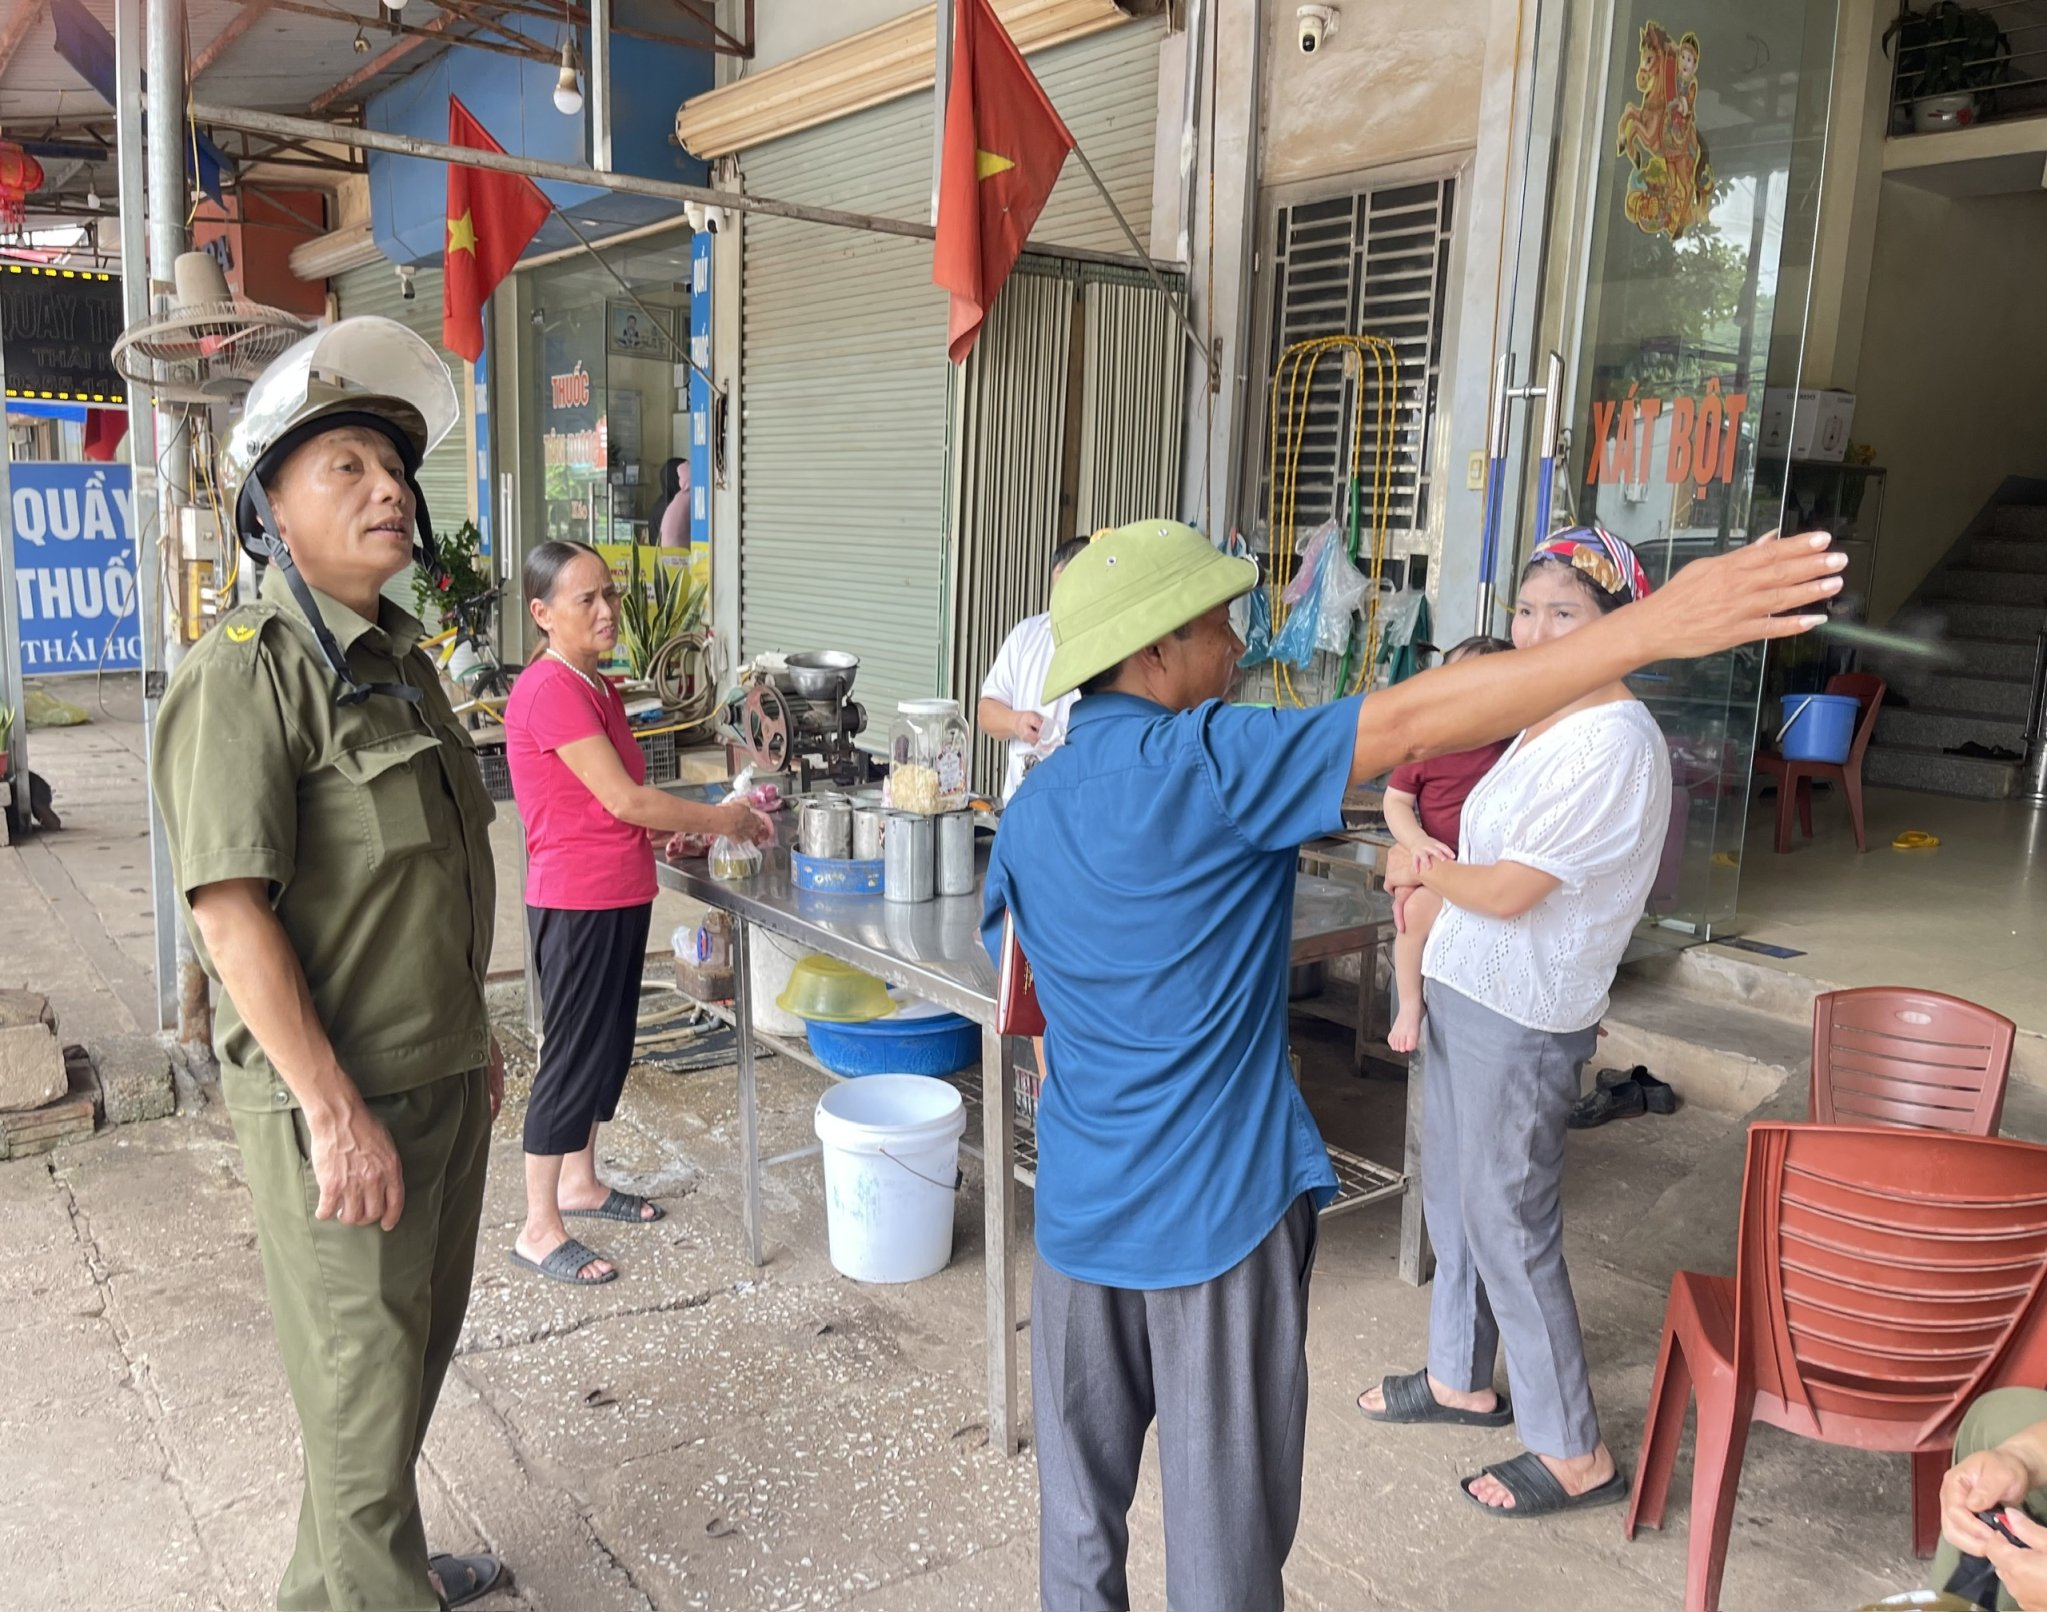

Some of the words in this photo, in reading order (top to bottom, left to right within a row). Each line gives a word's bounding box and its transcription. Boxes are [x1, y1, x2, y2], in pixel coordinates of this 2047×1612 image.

[551, 360, 590, 409] THUỐC
[1587, 380, 1661, 485] XÁT
[1665, 375, 1747, 500] BỘT
[13, 471, 135, 547] QUẦY
[16, 549, 136, 621] THUỐ
[21, 630, 98, 664] THÁI
